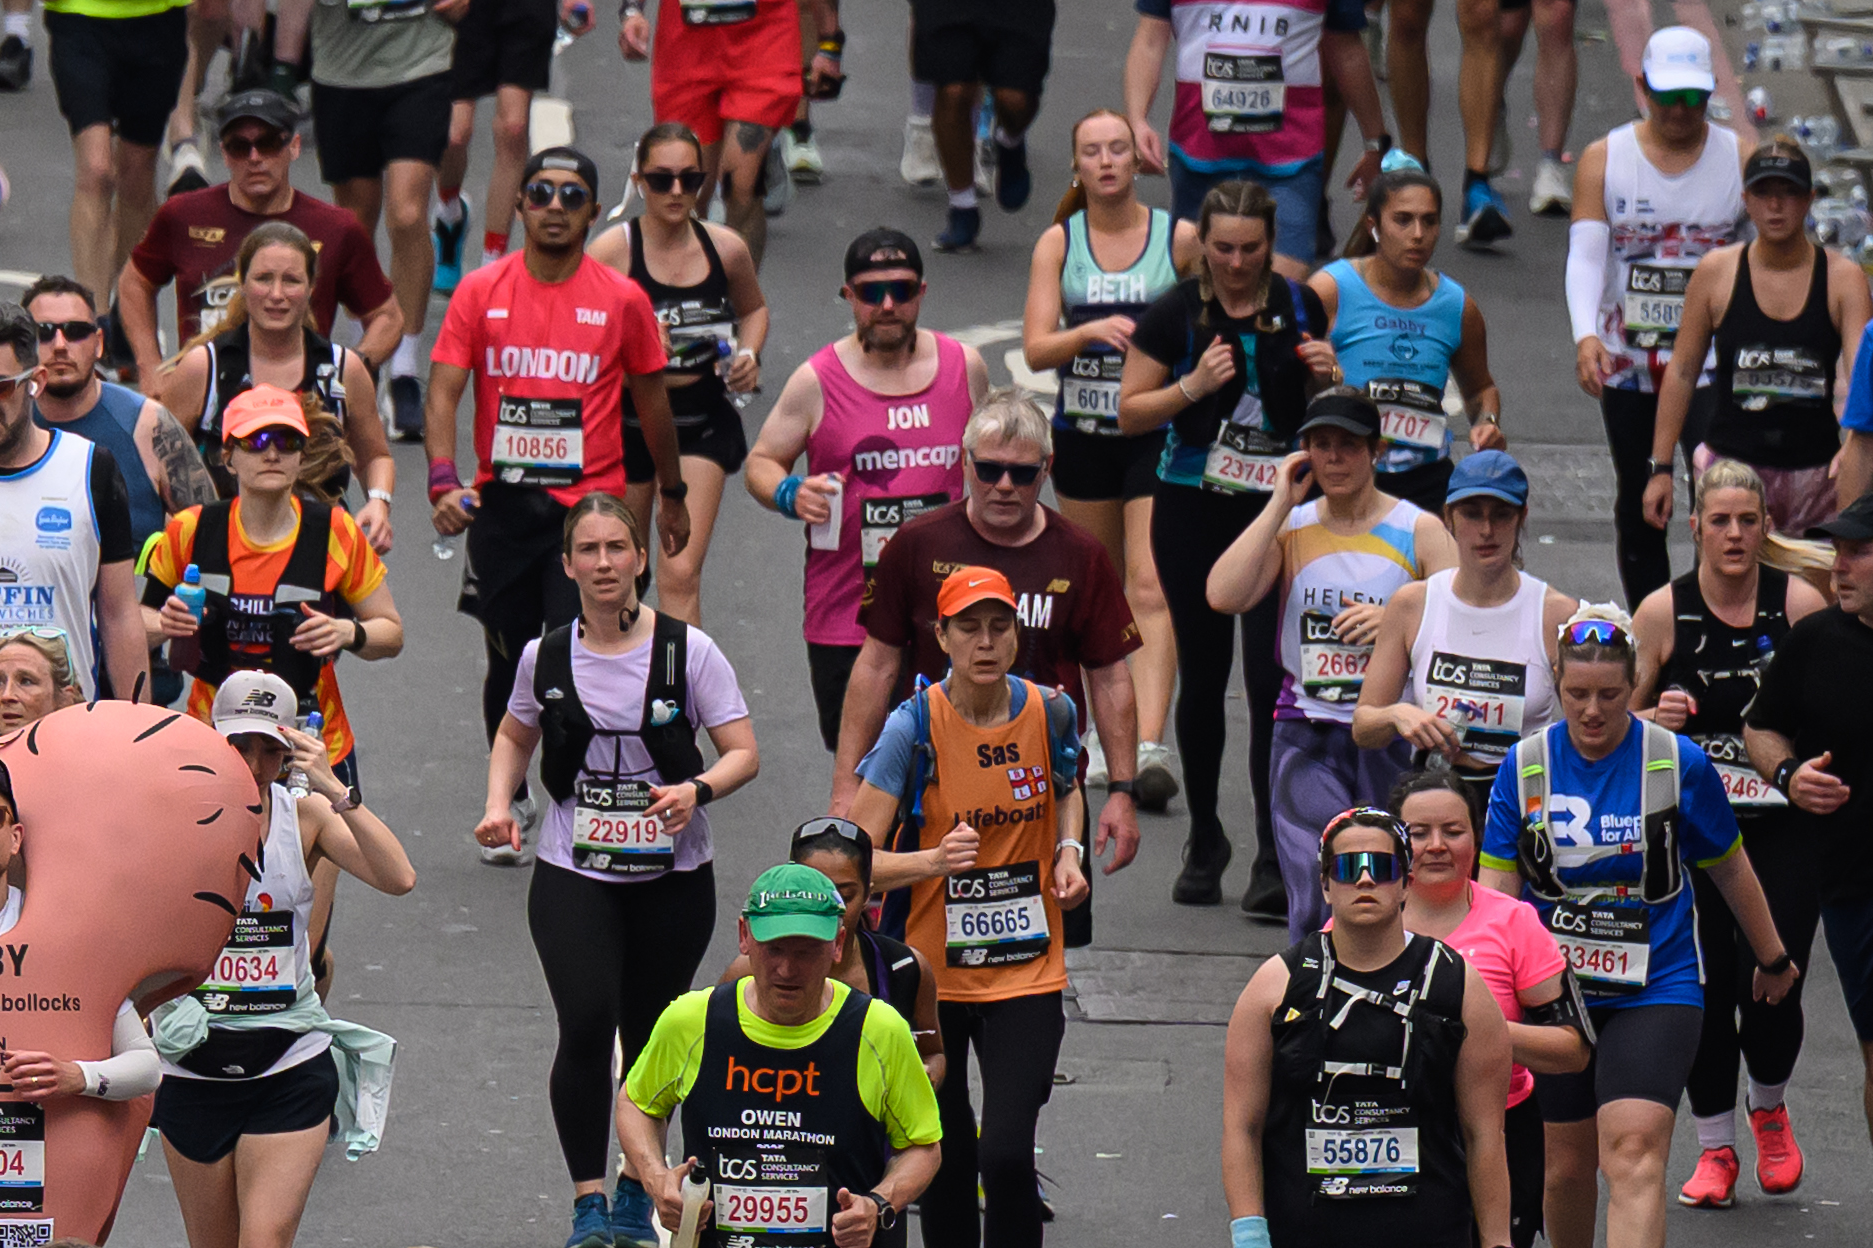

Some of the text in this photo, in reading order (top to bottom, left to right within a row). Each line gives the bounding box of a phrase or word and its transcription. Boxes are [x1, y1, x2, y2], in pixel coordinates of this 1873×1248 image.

[1208, 13, 1290, 36] RNIB
[1087, 273, 1147, 303] BETH
[576, 308, 607, 326] TAM
[1375, 316, 1426, 335] Gabby
[486, 346, 600, 384] LONDON
[500, 401, 527, 424] tcs
[887, 404, 929, 431] JON
[506, 435, 568, 460] 10856
[856, 444, 959, 472] mencap
[865, 502, 899, 524] tcs
[1304, 587, 1383, 608] HELEN
[1307, 618, 1339, 640] tcs
[1432, 657, 1467, 685] tcs
[977, 742, 1020, 768] Sas
[583, 784, 613, 807] tcs
[955, 801, 1046, 827] Lifeboats
[589, 818, 658, 843] 22919
[1601, 829, 1641, 842] for All
[949, 876, 985, 898] tcs
[961, 907, 1031, 937] 66665
[1552, 905, 1587, 933] tcs
[1590, 919, 1643, 931] CONSULTANCY
[1591, 911, 1615, 920] TATA
[235, 925, 288, 934] CONSULTANCY
[235, 934, 270, 942] SERVICES
[1590, 927, 1624, 937] SERVICES
[248, 1002, 287, 1011] balance
[726, 1056, 820, 1102] hcpt
[742, 1109, 801, 1127] OWEN
[1312, 1099, 1350, 1124] tcs
[1354, 1107, 1411, 1116] CONSULTANCY
[708, 1126, 835, 1145] LONDON MARATHON
[761, 1154, 787, 1162] TATA
[1323, 1137, 1401, 1165] 55876
[719, 1152, 756, 1180] tcs
[761, 1163, 820, 1172] CONSULTANCY
[761, 1172, 799, 1181] SERVICES
[1369, 1183, 1408, 1194] balance
[728, 1195, 809, 1223] 29955
